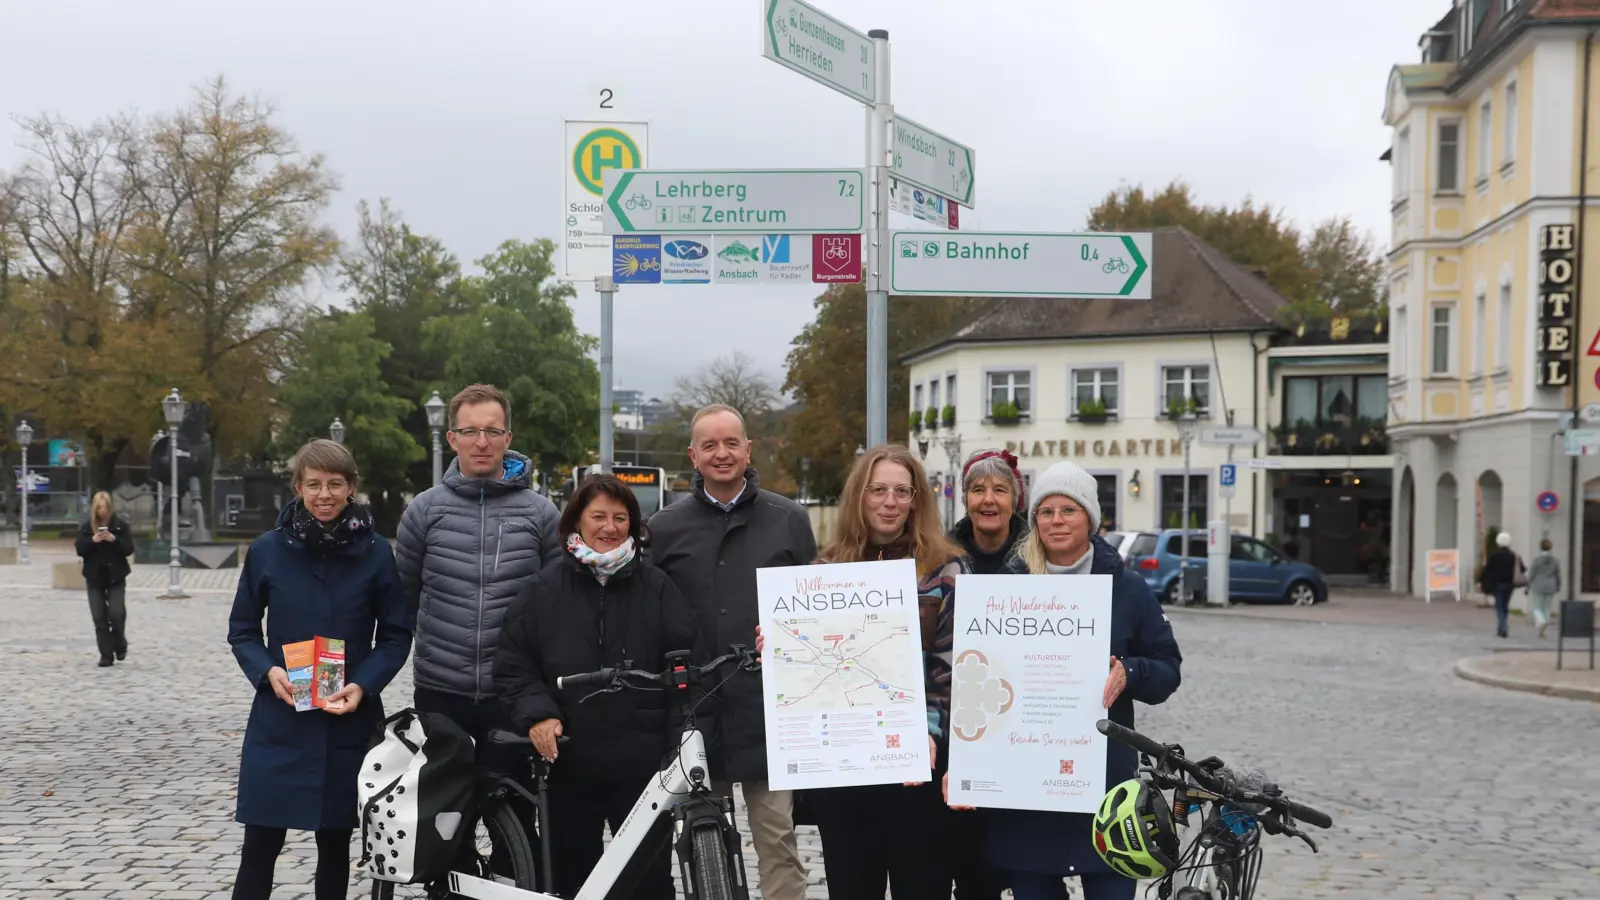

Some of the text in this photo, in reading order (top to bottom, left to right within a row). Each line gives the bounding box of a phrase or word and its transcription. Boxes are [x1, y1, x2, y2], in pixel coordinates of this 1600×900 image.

[800, 12, 868, 64] Gunzenhausen 30
[788, 34, 868, 90] Herrieden 11
[599, 88, 614, 109] 2
[897, 126, 956, 167] Windsbach 22
[893, 152, 903, 170] yb
[654, 180, 747, 202] Lehrberg
[701, 205, 787, 224] Zentrum
[946, 242, 1030, 260] Bahnhof
[718, 269, 758, 279] Ansbach
[816, 273, 857, 281] Burgenstraße
[1547, 225, 1573, 385] HOTEL
[617, 473, 655, 484] friedhof
[795, 576, 868, 596] Willkommen in
[773, 589, 904, 614] ANSBACH
[986, 596, 1007, 616] Auf
[1010, 595, 1068, 616] Wiedersehen
[966, 617, 1095, 636] ANSBACH
[1042, 733, 1053, 746] Sie
[870, 752, 919, 763] ANSBACH
[1042, 780, 1091, 788] ANSBACH
